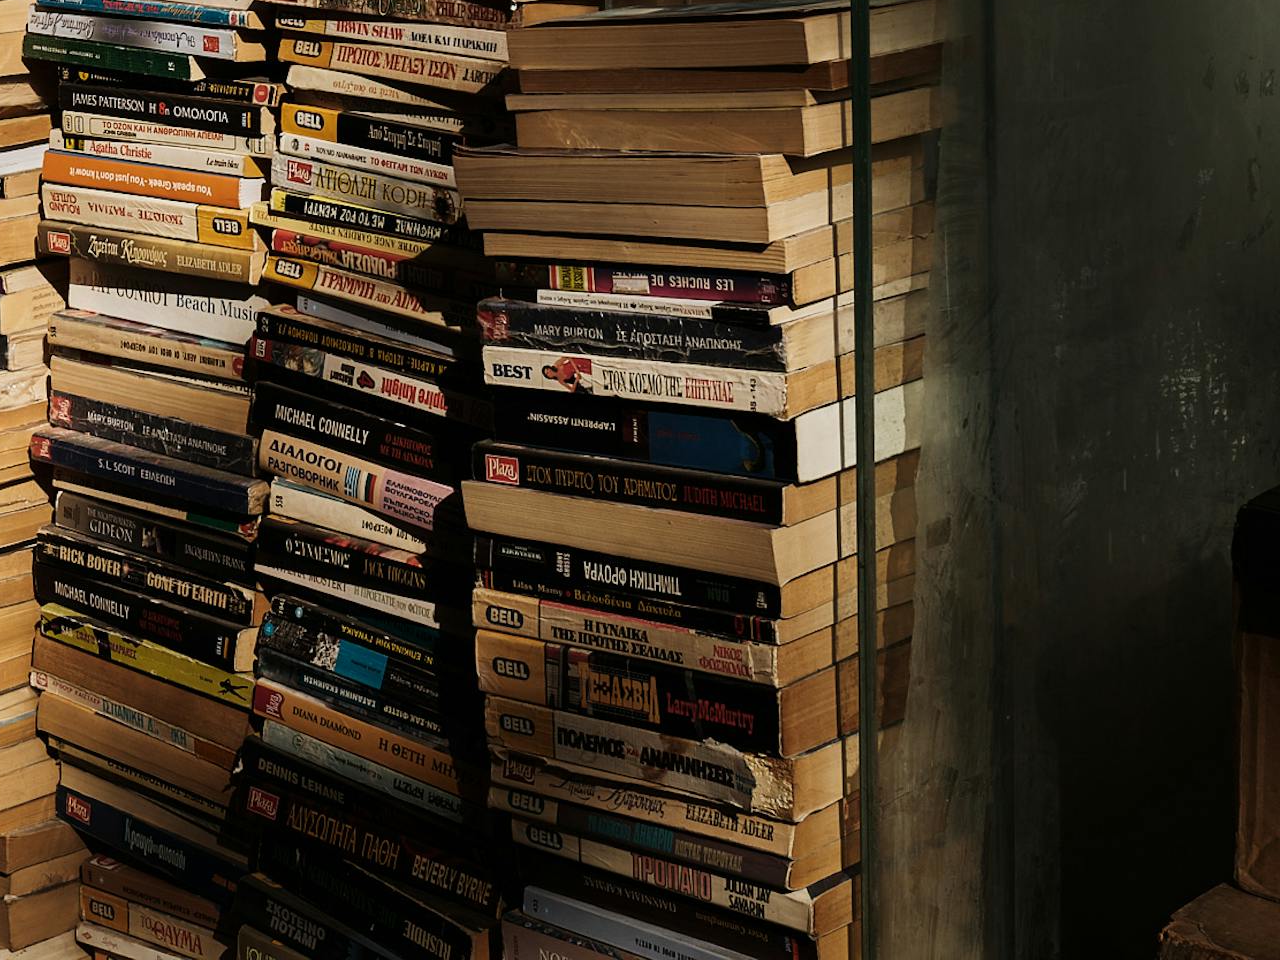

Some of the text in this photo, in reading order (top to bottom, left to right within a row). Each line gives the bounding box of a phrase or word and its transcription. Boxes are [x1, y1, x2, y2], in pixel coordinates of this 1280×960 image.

[336, 21, 497, 52] IRWIN SHAW ΠΑΡΑΚΜΗ
[336, 46, 458, 80] ΠΡΩΤΟΣ ΜΕΤΑΞΥ ΙΣΩΝ
[72, 93, 228, 124] JAMES PATTERSON ΟΜΟΛΟΓΙΑ
[153, 126, 195, 138] ΑΝΘΡΩΠΙΝΗ
[89, 142, 153, 159] Agatha Christie
[69, 167, 213, 197] You speak Greek You just don't know it
[425, 168, 448, 180] ΛΥΚΩΝ
[49, 201, 80, 215] ROLAND
[50, 191, 77, 204] CUTLER
[304, 201, 337, 219] ΚΕΝΤΡΙ
[177, 255, 242, 274] ELIZABETH ADLER
[276, 260, 301, 278] BELL
[320, 271, 376, 303] ΓΡΑΜΜΗ
[651, 274, 734, 291] LES RUCHES DE
[176, 293, 258, 322] Beach Music
[534, 324, 604, 340] MARY BURTON
[492, 363, 533, 379] BEST
[602, 369, 683, 397] ΣΤΟΝ ΚΟΣΜΟ ΤΗΣ
[106, 416, 134, 432] BURTON
[275, 403, 370, 446] MICHAEL CONNELLY
[113, 461, 135, 476] SCOTT
[269, 440, 342, 474] ΔΙΑΛΟΓΟΙ
[488, 457, 517, 484] Plaza
[268, 457, 339, 492] РАЗГОВОРНИК
[89, 519, 133, 543] GIDEON
[59, 545, 227, 609] RICK BOYER GONE TO EARTH
[363, 559, 426, 590] JACK HIGGINS
[583, 561, 682, 596] ΤΙΜΗΤΙΚΗ ΦΡΟΥΡΑ
[55, 580, 129, 620] MICHAEL CONNELLY
[490, 609, 521, 626] BELL
[595, 621, 649, 643] ΓΥΝΑΙΚΑ
[631, 642, 684, 665] ΣΕΛΙΔΑΣ
[497, 660, 528, 678] BELL
[292, 706, 319, 728] DIANA
[320, 716, 362, 741] DIAMOND
[503, 715, 532, 735] BELL
[666, 692, 755, 736] Larry McMurtry
[557, 726, 625, 759] ΠΟΛΕΜΟΣ
[258, 757, 345, 805] DENNIS LEHANE
[249, 789, 277, 818] Plaza
[685, 803, 774, 842] ELIZABETH ADLER
[530, 829, 560, 849] BELL
[286, 800, 493, 907] ΑΔΥΣΩΠΗΤΑ ΠΑΘΗ BEVERLY BYRNE
[90, 900, 114, 921] BELL
[265, 898, 325, 939] ΣΚΟΤΕΙΝΟ
[150, 916, 204, 957] ΘΑΥΜΑ
